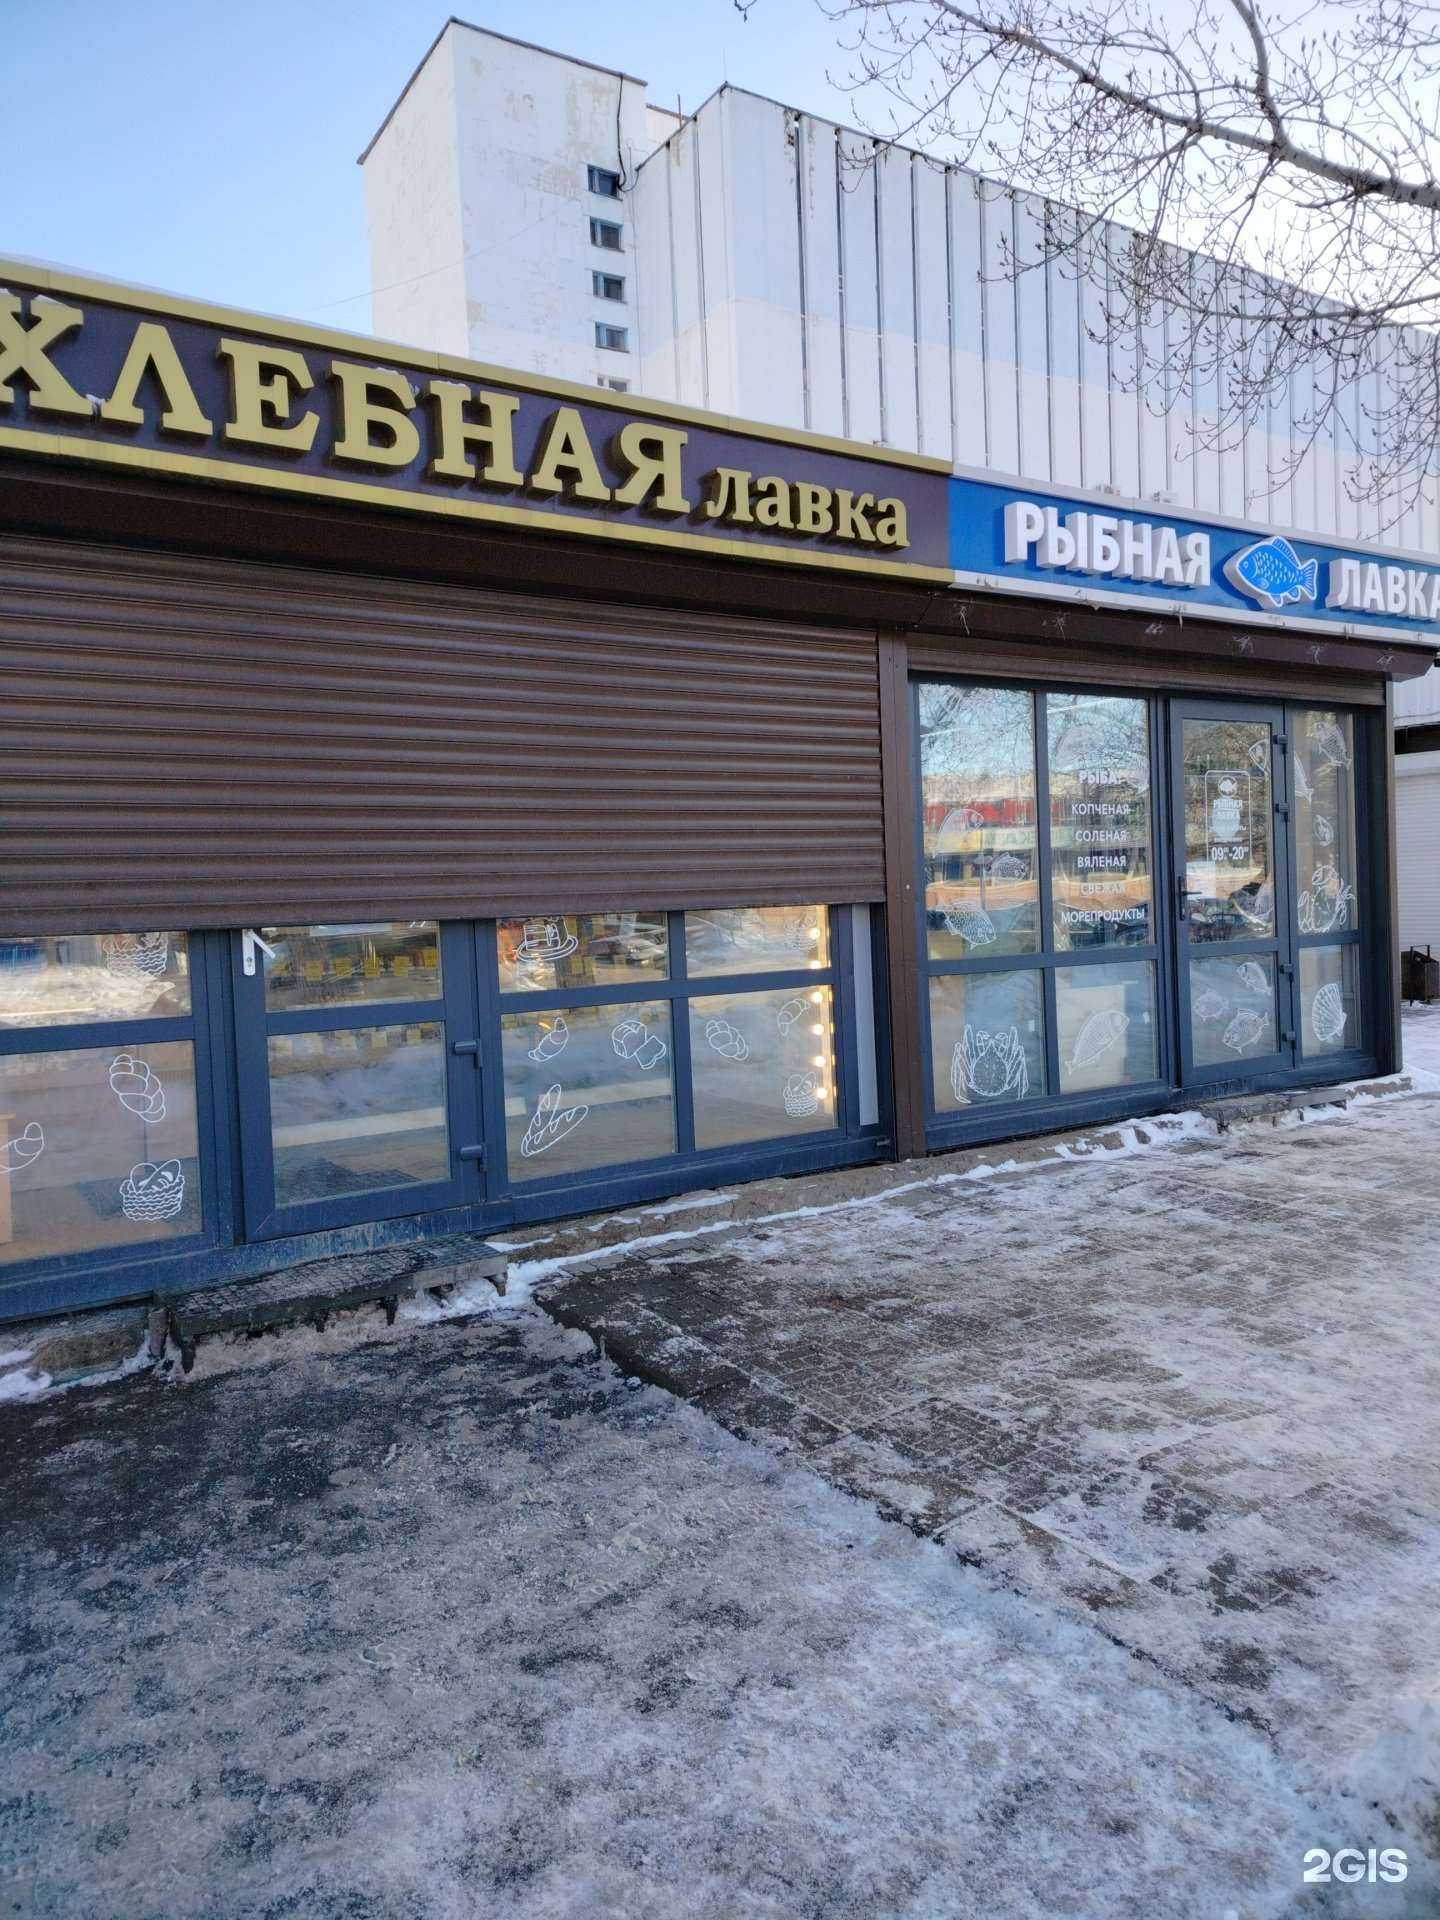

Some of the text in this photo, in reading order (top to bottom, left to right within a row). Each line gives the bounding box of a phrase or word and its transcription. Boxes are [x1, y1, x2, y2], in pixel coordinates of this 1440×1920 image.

[0, 288, 910, 546] ХЛЕБНАЯ лавка
[1004, 502, 1210, 587] РЫБНАЯ
[1071, 803, 1129, 816] КОПЧЕНАЯ
[1075, 829, 1127, 842] СОЛЕНАЯ
[1077, 855, 1127, 868] ВЯЛЕНАЯ
[1061, 908, 1145, 923] МОРЕПРОДУКТЫ
